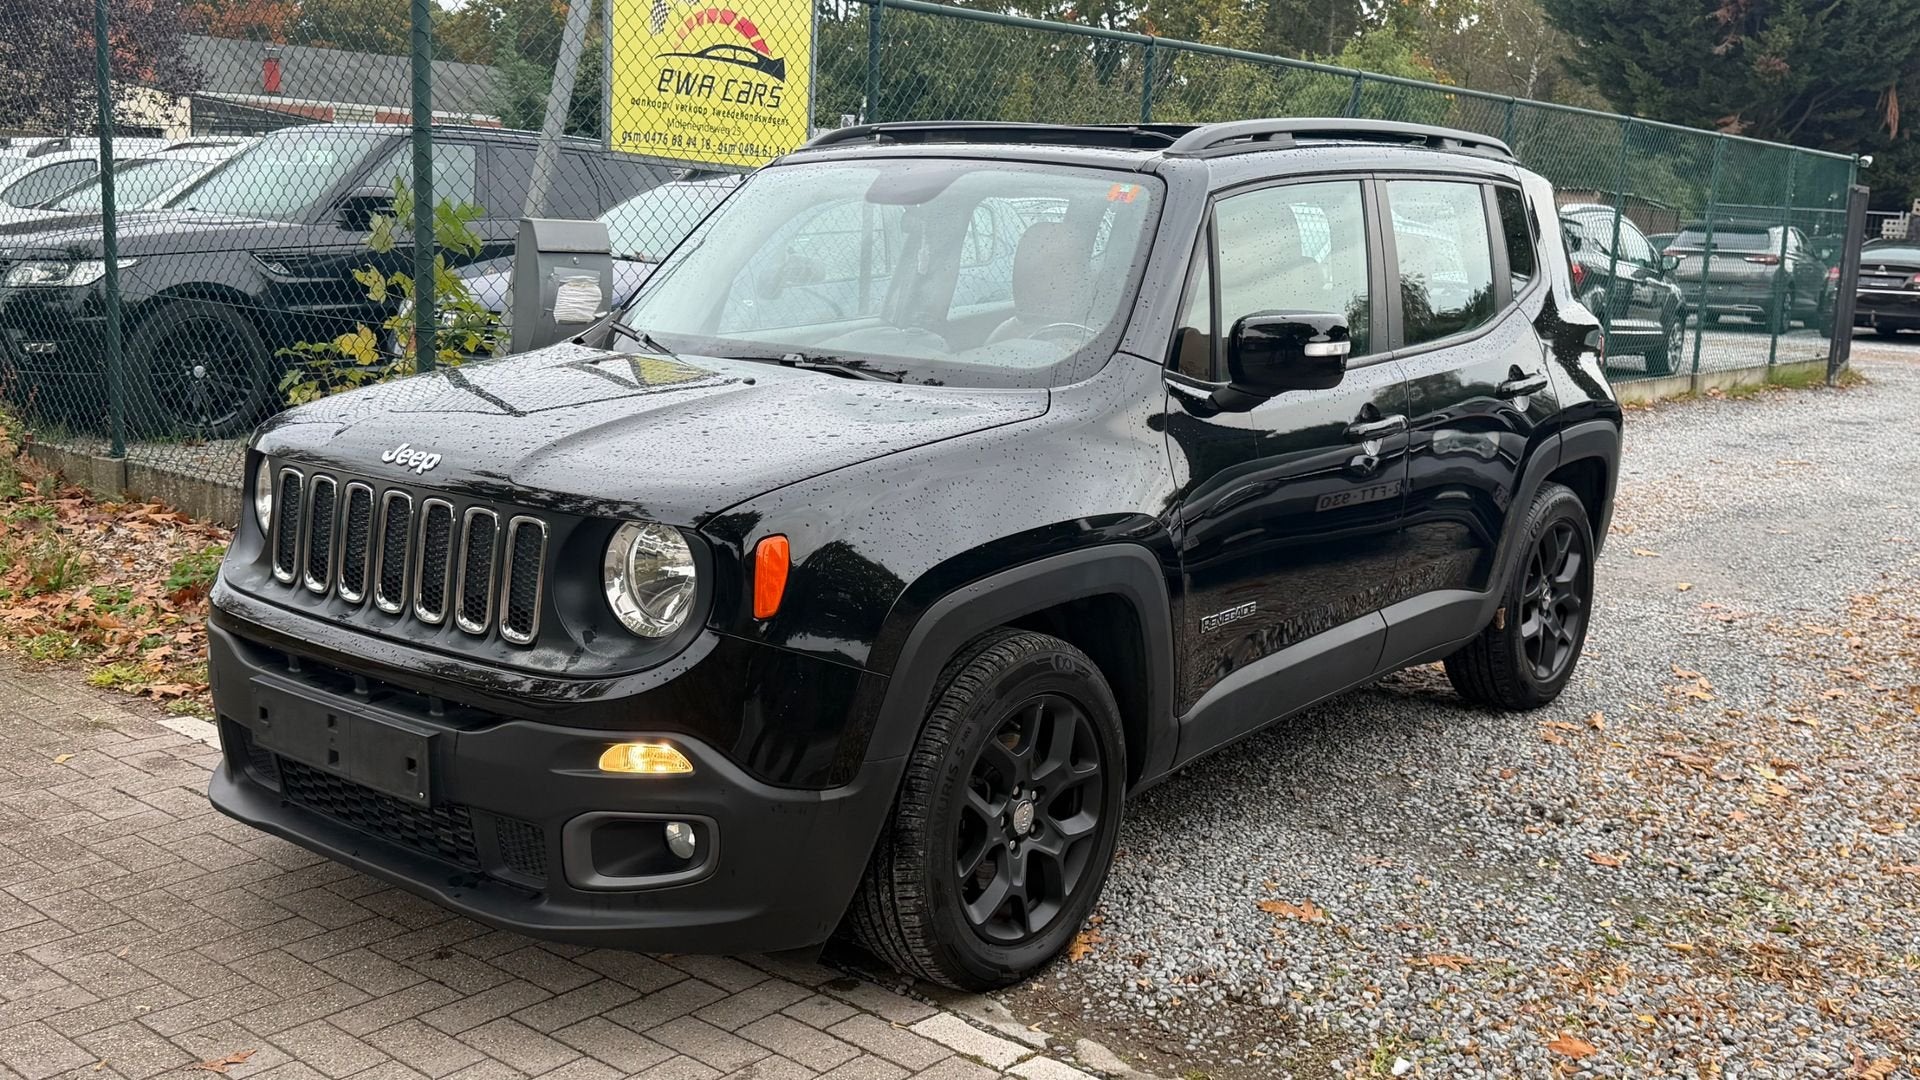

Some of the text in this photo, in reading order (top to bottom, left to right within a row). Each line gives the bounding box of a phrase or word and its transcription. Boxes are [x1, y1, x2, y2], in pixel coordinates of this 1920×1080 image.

[675, 103, 708, 116] verkoop
[712, 108, 788, 126] tweedehandswagens
[622, 131, 641, 144] gsm
[644, 131, 668, 145] 0476
[701, 138, 711, 150] 18
[717, 141, 737, 154] gsm
[738, 143, 760, 156] 0484
[381, 442, 442, 475] Jeep
